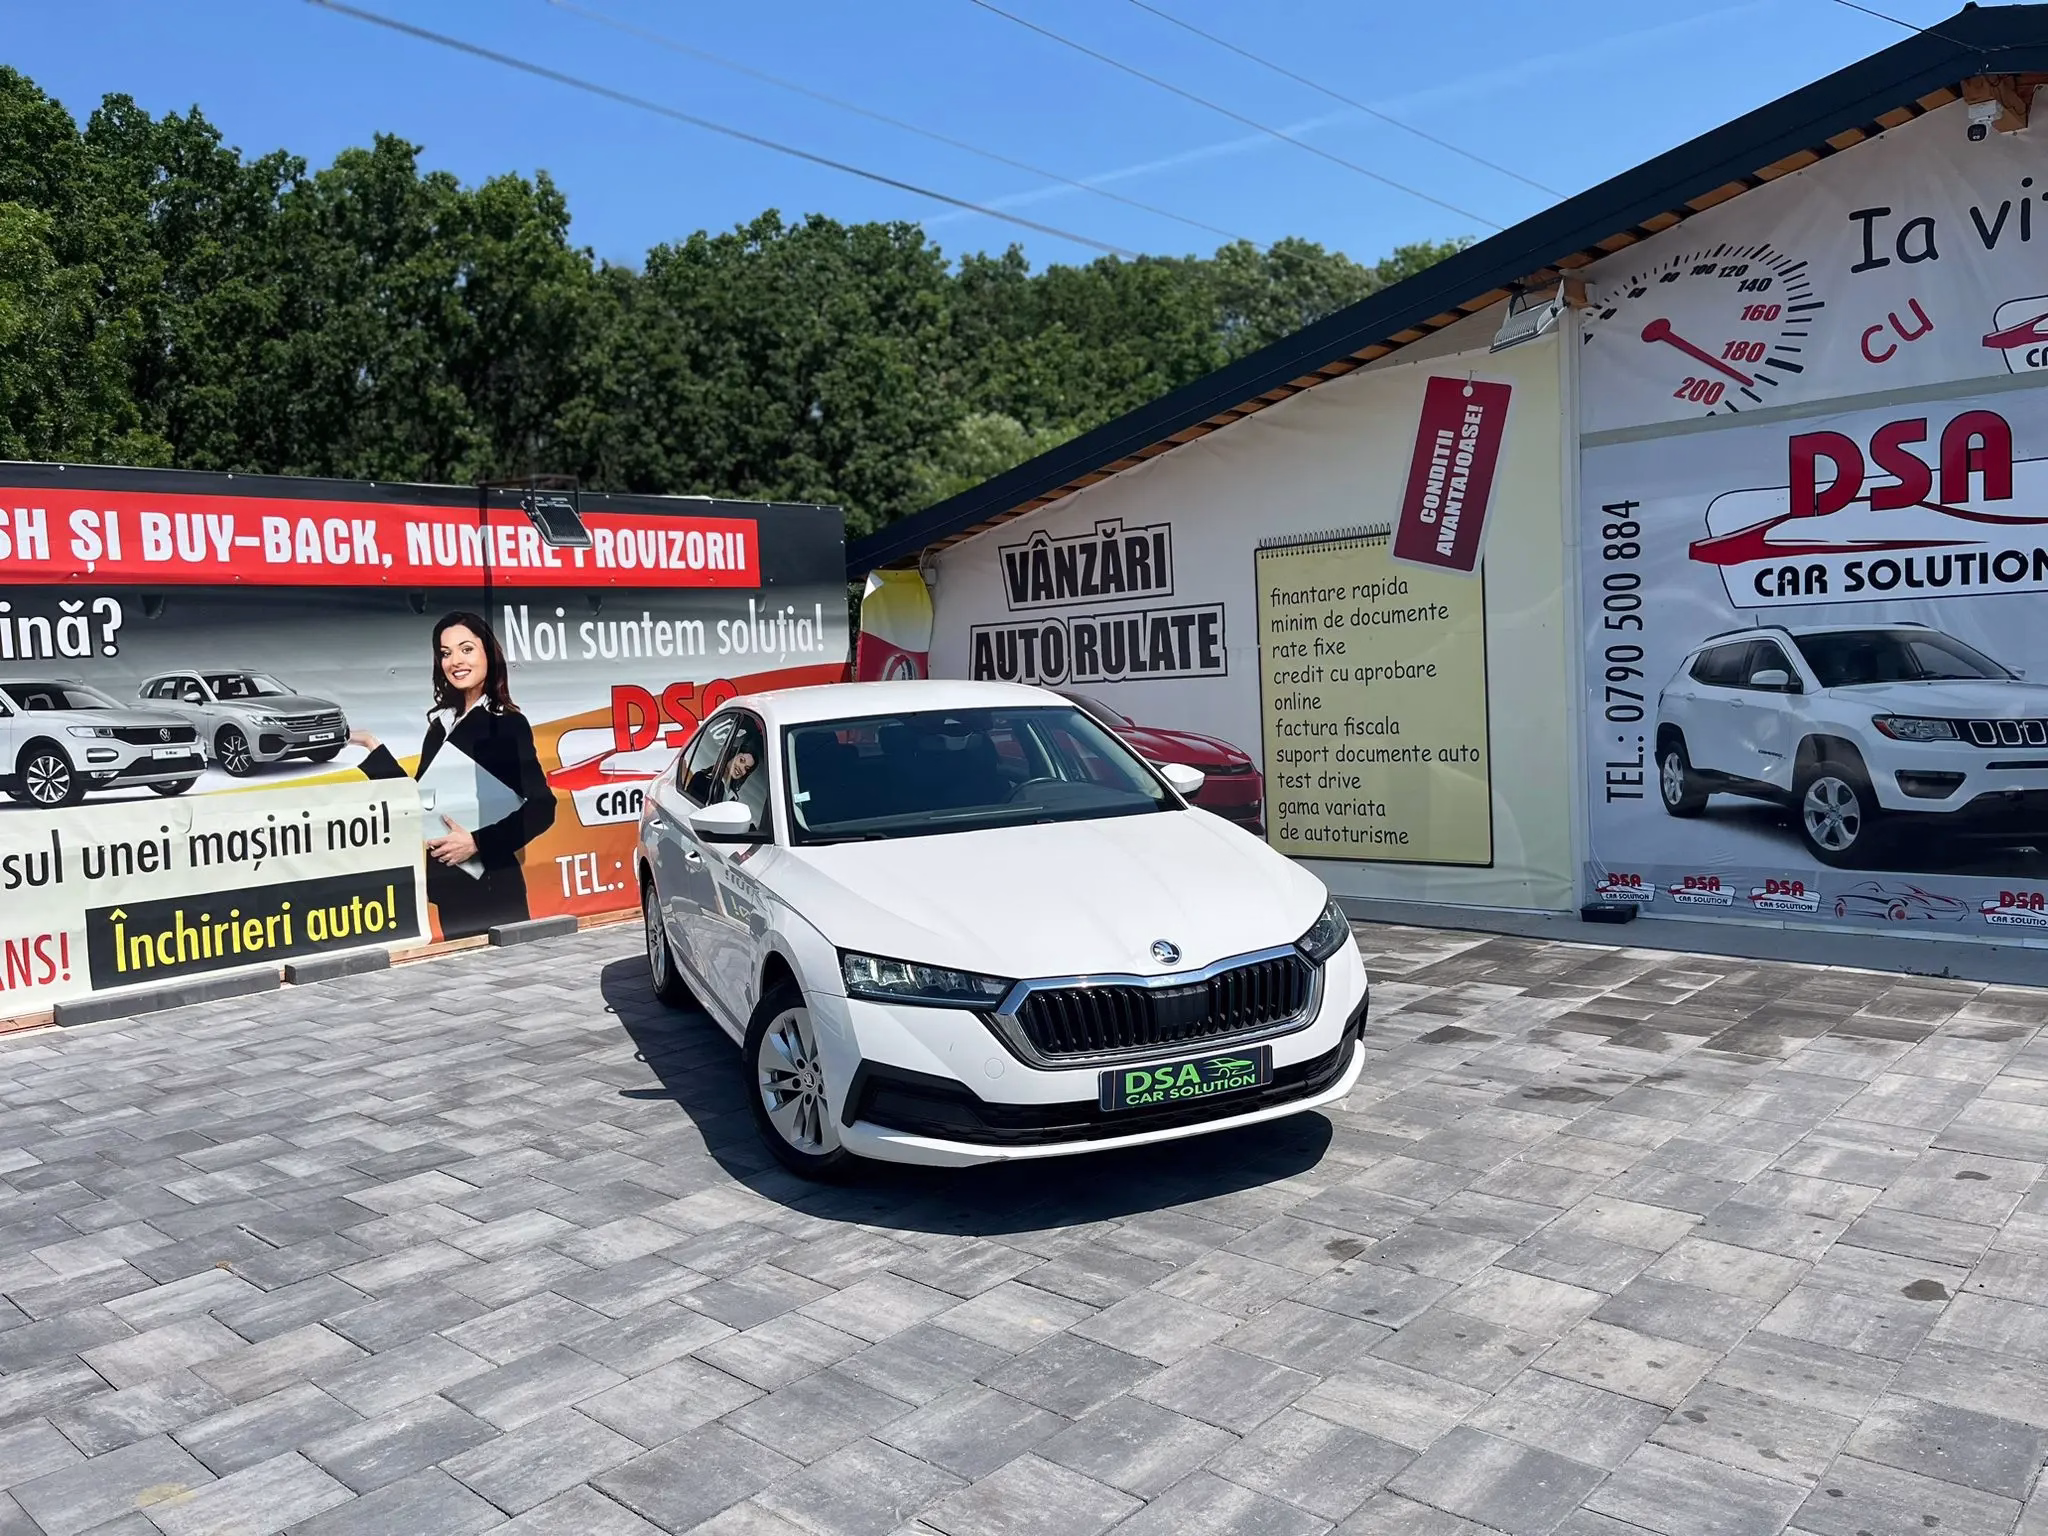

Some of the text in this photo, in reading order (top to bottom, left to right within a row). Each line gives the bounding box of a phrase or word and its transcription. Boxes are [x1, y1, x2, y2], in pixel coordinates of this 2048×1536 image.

[1849, 176, 2048, 274] Ia vi
[1718, 264, 1749, 278] 120
[1737, 277, 1773, 292] 140
[1740, 304, 1782, 321] 160
[1861, 298, 1934, 364] cu
[1720, 341, 1766, 362] 180
[1673, 377, 1726, 405] 200
[1420, 429, 1455, 524] CONDITII
[1789, 410, 2013, 519] DSA
[1436, 404, 1484, 557] AVANTAJOASE!
[68, 509, 122, 573] ȘI
[139, 511, 393, 569] BUY-BACK,
[405, 522, 562, 568] NUMERE
[1006, 528, 1168, 604] VÂNZĂRI
[1754, 564, 1828, 597] CAR
[1270, 576, 1409, 607] finantare rapida
[503, 599, 825, 663] Noi suntem soluția!
[1271, 602, 1450, 633] minim de documente
[974, 612, 1221, 681] AUTO RULATE
[1272, 637, 1346, 659] rate fixe
[1602, 500, 1644, 803] TEL.: 0790 500 884
[1273, 660, 1437, 686] credit cu aprobare
[1274, 692, 1322, 711] online
[1275, 716, 1400, 738] factura fiscala
[1276, 744, 1480, 767] suport documente auto
[1277, 771, 1362, 789] test drive
[596, 788, 644, 817] CAR
[1278, 798, 1386, 819] gama variata
[2, 801, 391, 890] sul unei mașini noi!
[1280, 823, 1409, 845] de autoturisme
[556, 854, 625, 899] TEL.:
[1684, 876, 1720, 891] DSA
[1766, 879, 1804, 896] DSA
[1776, 902, 1813, 911] SOLUTION
[2000, 891, 2044, 910] DSA
[109, 885, 397, 973] Închirieri auto!
[0, 932, 70, 991] NS!
[1125, 1064, 1201, 1094] DSA
[1126, 1074, 1256, 1105] CAR SOLUTION
